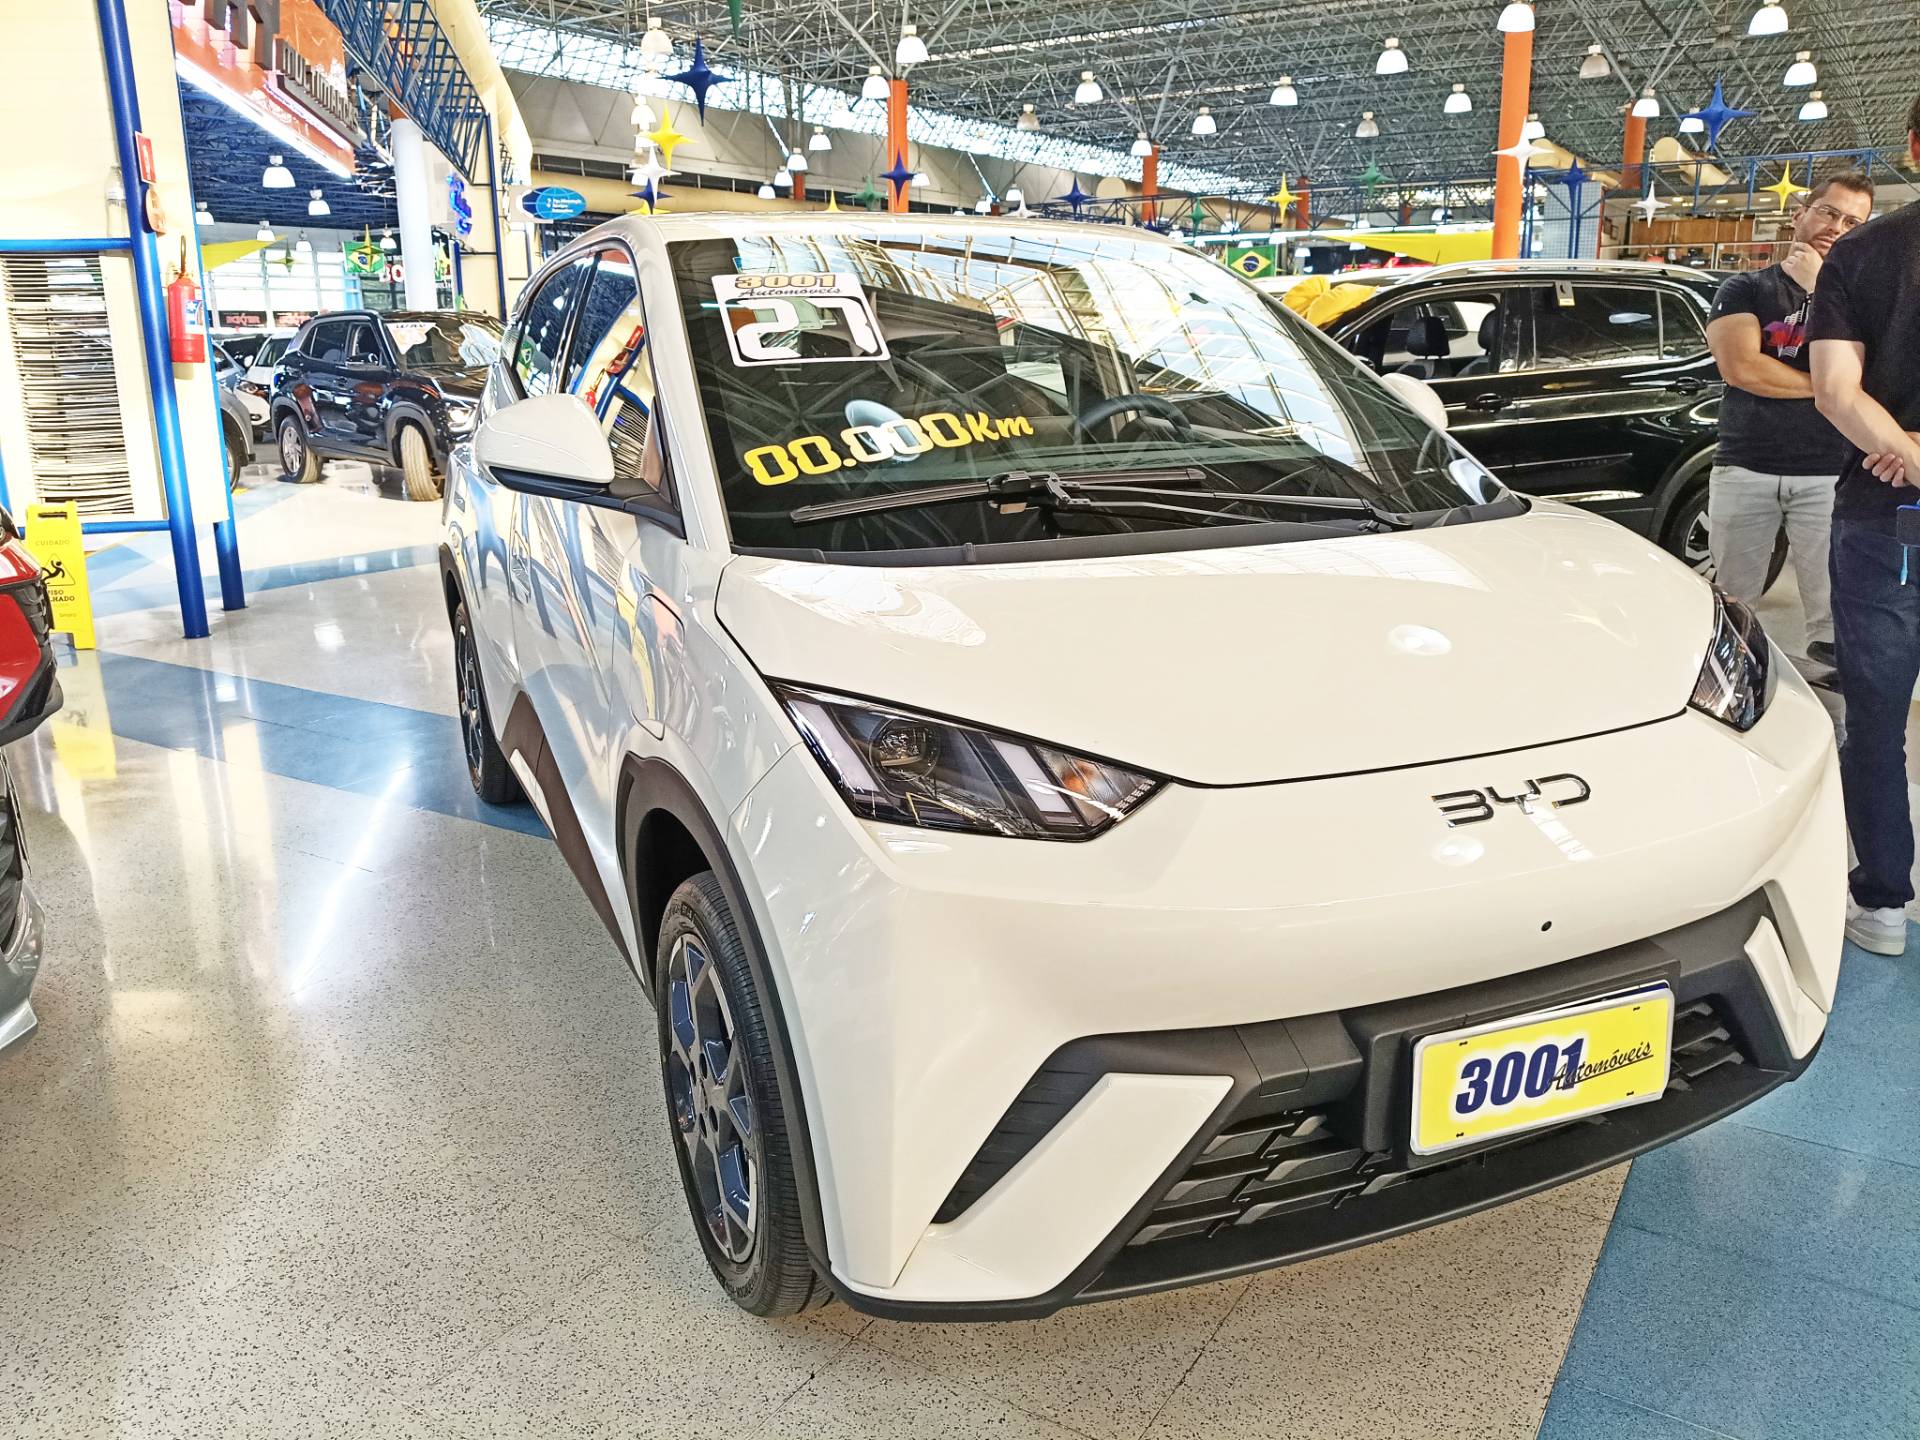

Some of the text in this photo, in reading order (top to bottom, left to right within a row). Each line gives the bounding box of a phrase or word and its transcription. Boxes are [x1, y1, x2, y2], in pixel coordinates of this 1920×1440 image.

[735, 273, 836, 289] 3001
[35, 539, 70, 547] CUIDADO
[1431, 773, 1591, 828] BYD
[1455, 1038, 1653, 1114] 3001 Automóveis
